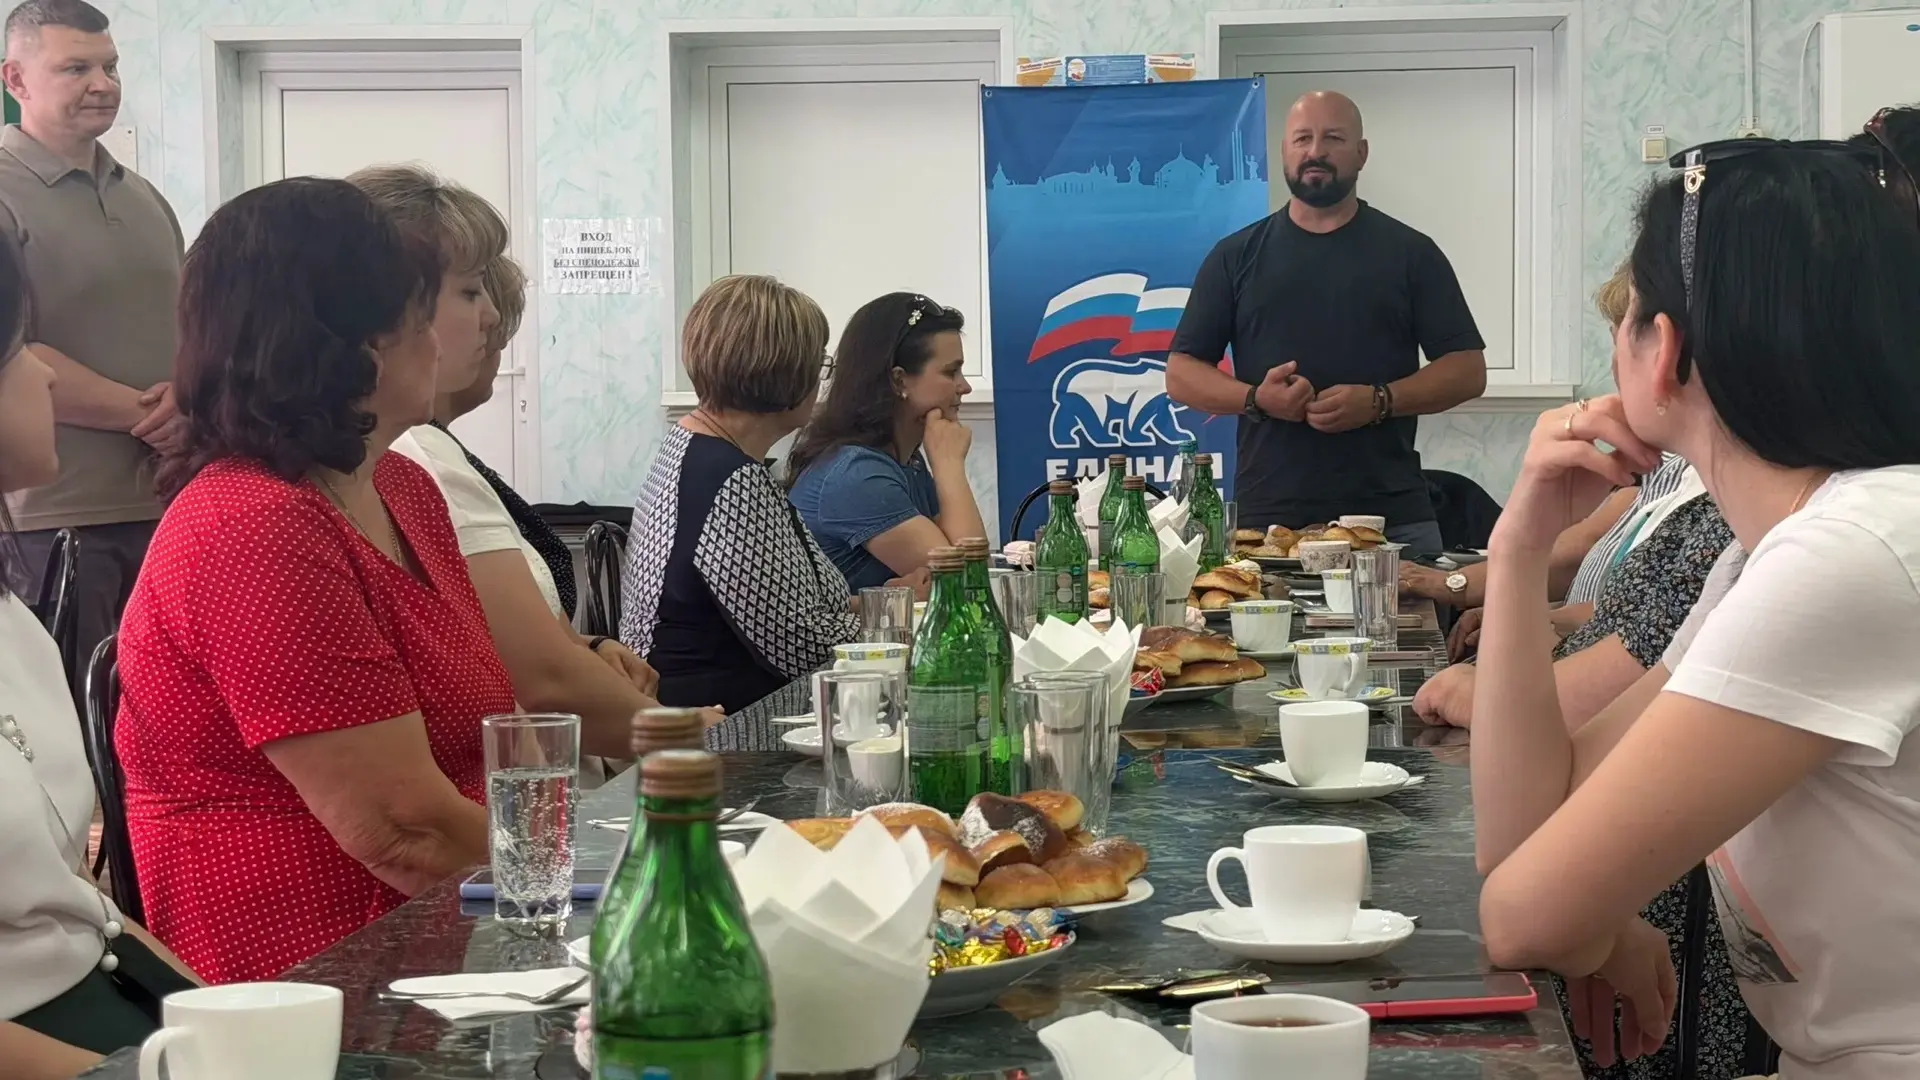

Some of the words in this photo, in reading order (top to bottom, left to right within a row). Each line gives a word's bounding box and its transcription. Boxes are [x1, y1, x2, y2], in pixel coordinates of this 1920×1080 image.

[581, 232, 612, 242] ВХОД
[562, 246, 575, 254] НА
[553, 258, 570, 268] БЕЗ
